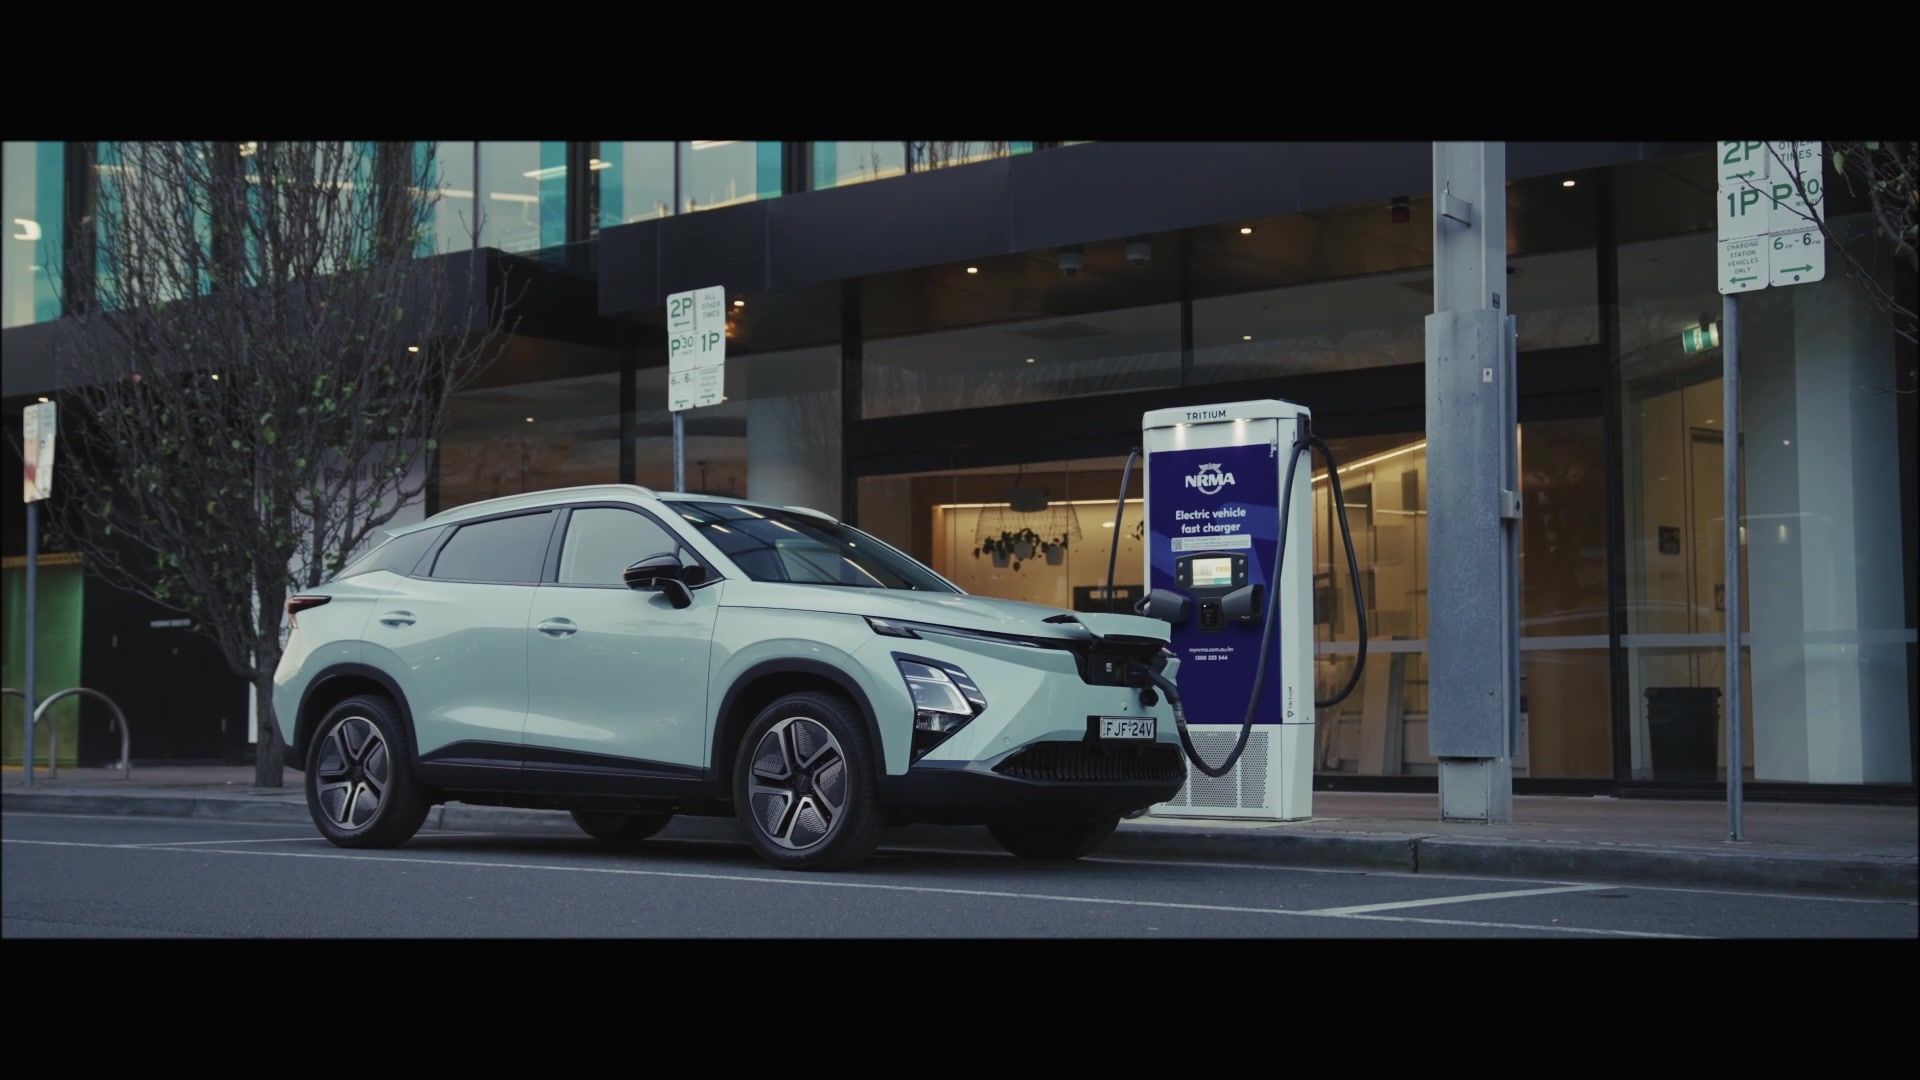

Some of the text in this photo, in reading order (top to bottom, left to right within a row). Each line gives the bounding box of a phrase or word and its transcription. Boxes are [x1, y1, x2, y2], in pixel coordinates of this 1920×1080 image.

[1723, 140, 1763, 165] 2P
[1727, 188, 1760, 218] 1P
[1727, 241, 1759, 251] CHARGING
[1730, 250, 1756, 259] STATION
[1728, 257, 1759, 267] VEHICLES
[1734, 266, 1751, 275] ONLY
[670, 297, 693, 319] 2P
[701, 302, 720, 311] OTHER
[702, 311, 720, 319] TIMES
[701, 332, 720, 353] 1P
[1186, 410, 1226, 421] TRITIUM
[1185, 472, 1236, 488] NRMA
[1175, 507, 1247, 520] Electric vehicle
[1181, 522, 1241, 535] fast charger
